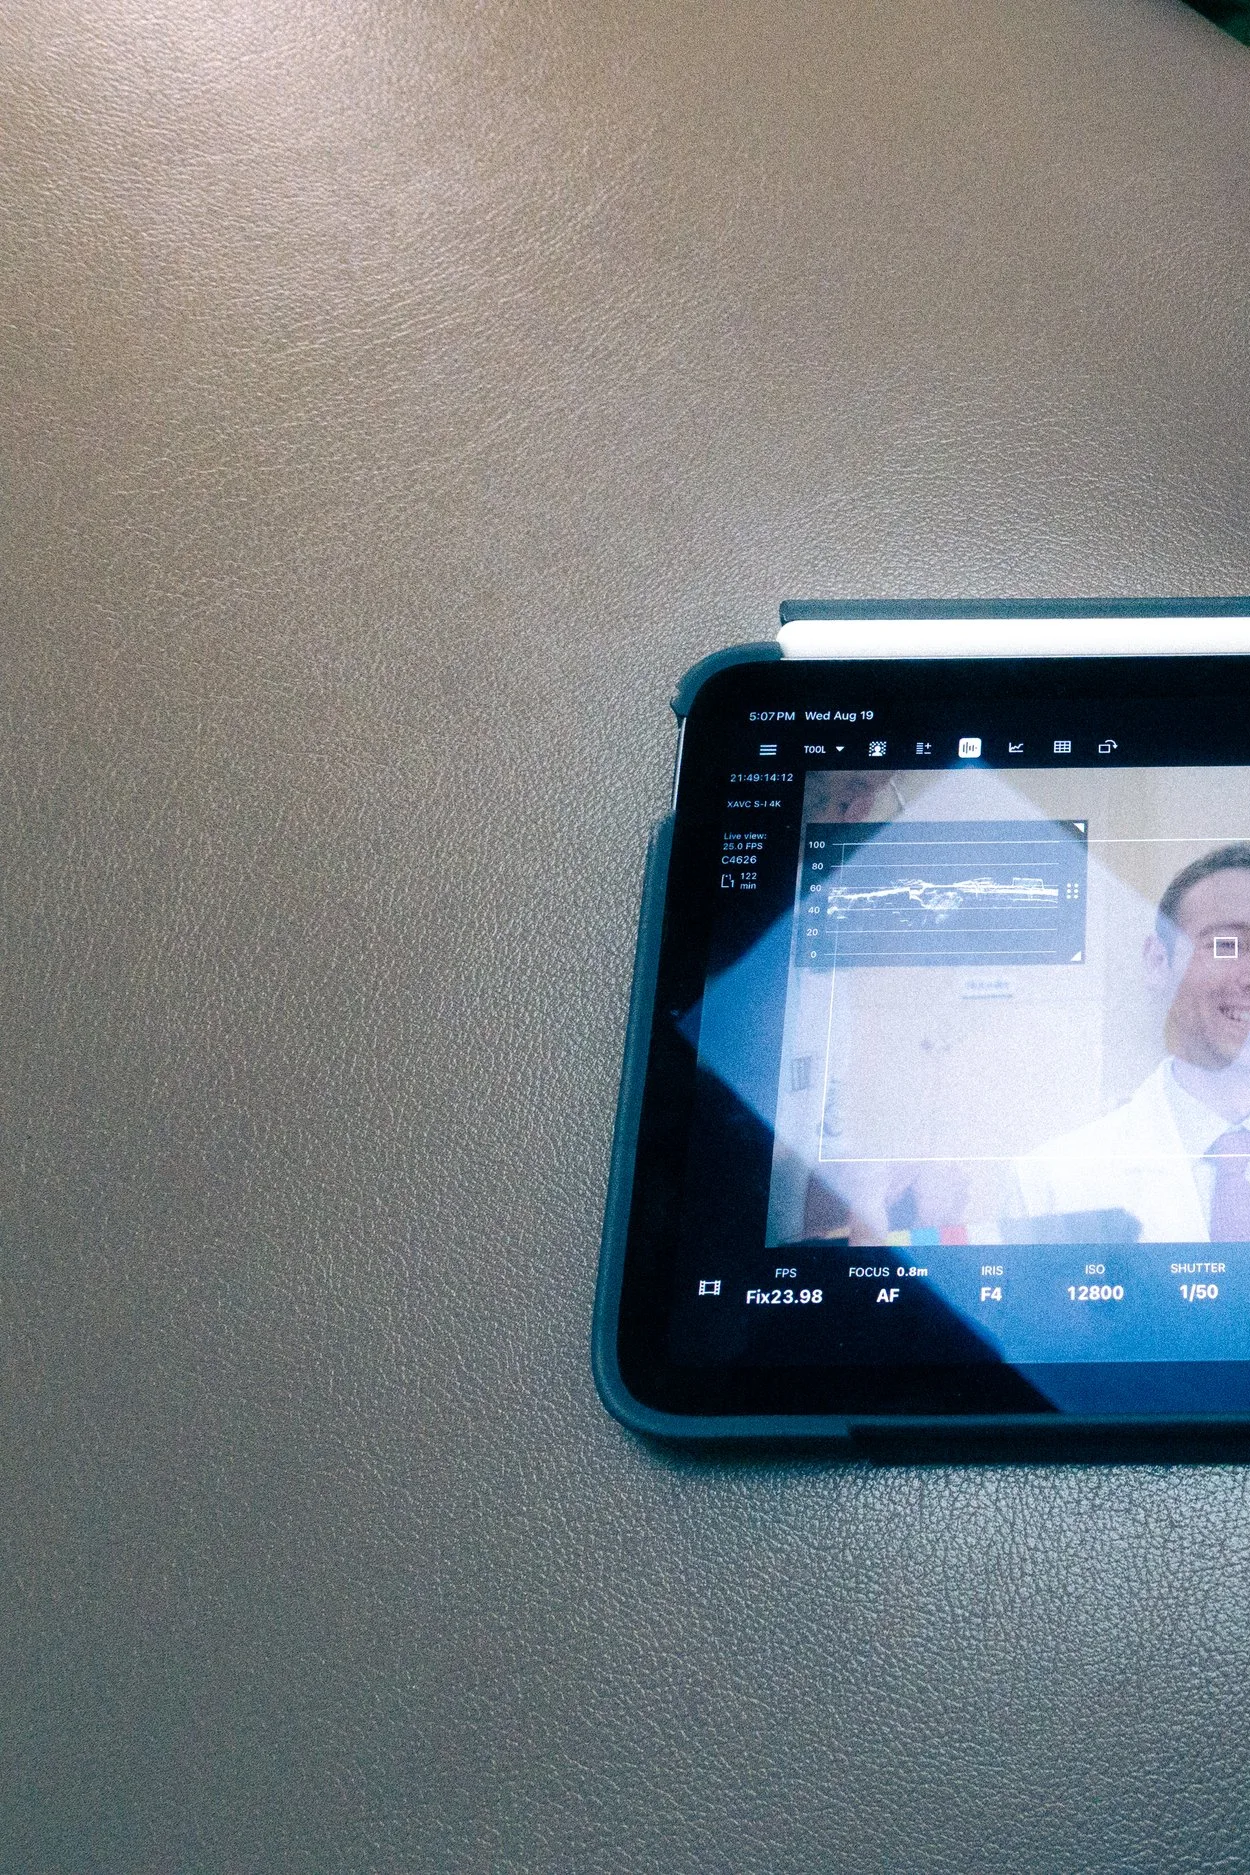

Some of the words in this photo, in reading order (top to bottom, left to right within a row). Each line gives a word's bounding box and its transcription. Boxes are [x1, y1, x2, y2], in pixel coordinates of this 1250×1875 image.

[805, 711, 831, 721] Wed
[834, 711, 857, 722] Aug
[860, 710, 874, 720] 19
[804, 745, 826, 754] TOOL
[730, 773, 794, 783] 21:49:14:12
[727, 800, 752, 808] XAVC
[769, 800, 782, 808] 4K
[723, 832, 742, 840] Live
[744, 832, 768, 840] view:
[723, 842, 743, 850] 25.0
[745, 842, 763, 850] FPS
[808, 840, 825, 849] 100
[721, 855, 757, 865] C4626
[811, 862, 823, 871] 80
[740, 872, 757, 880] 122
[739, 881, 757, 890] min
[810, 884, 821, 892] 60
[808, 905, 820, 914] 40
[806, 927, 818, 937] 20
[810, 950, 817, 959] 0
[775, 1268, 797, 1278] FPS
[848, 1267, 890, 1278] FOCUS
[896, 1266, 928, 1277] 0.8m
[981, 1265, 1004, 1276] IRIS
[1085, 1264, 1106, 1275] ISO
[1170, 1262, 1226, 1274] SHUTTER
[746, 1289, 823, 1305] Fix23.98
[876, 1288, 900, 1304] AF
[980, 1287, 1003, 1302] F4
[1067, 1285, 1124, 1301] 12800
[1179, 1284, 1219, 1302] 1/50
